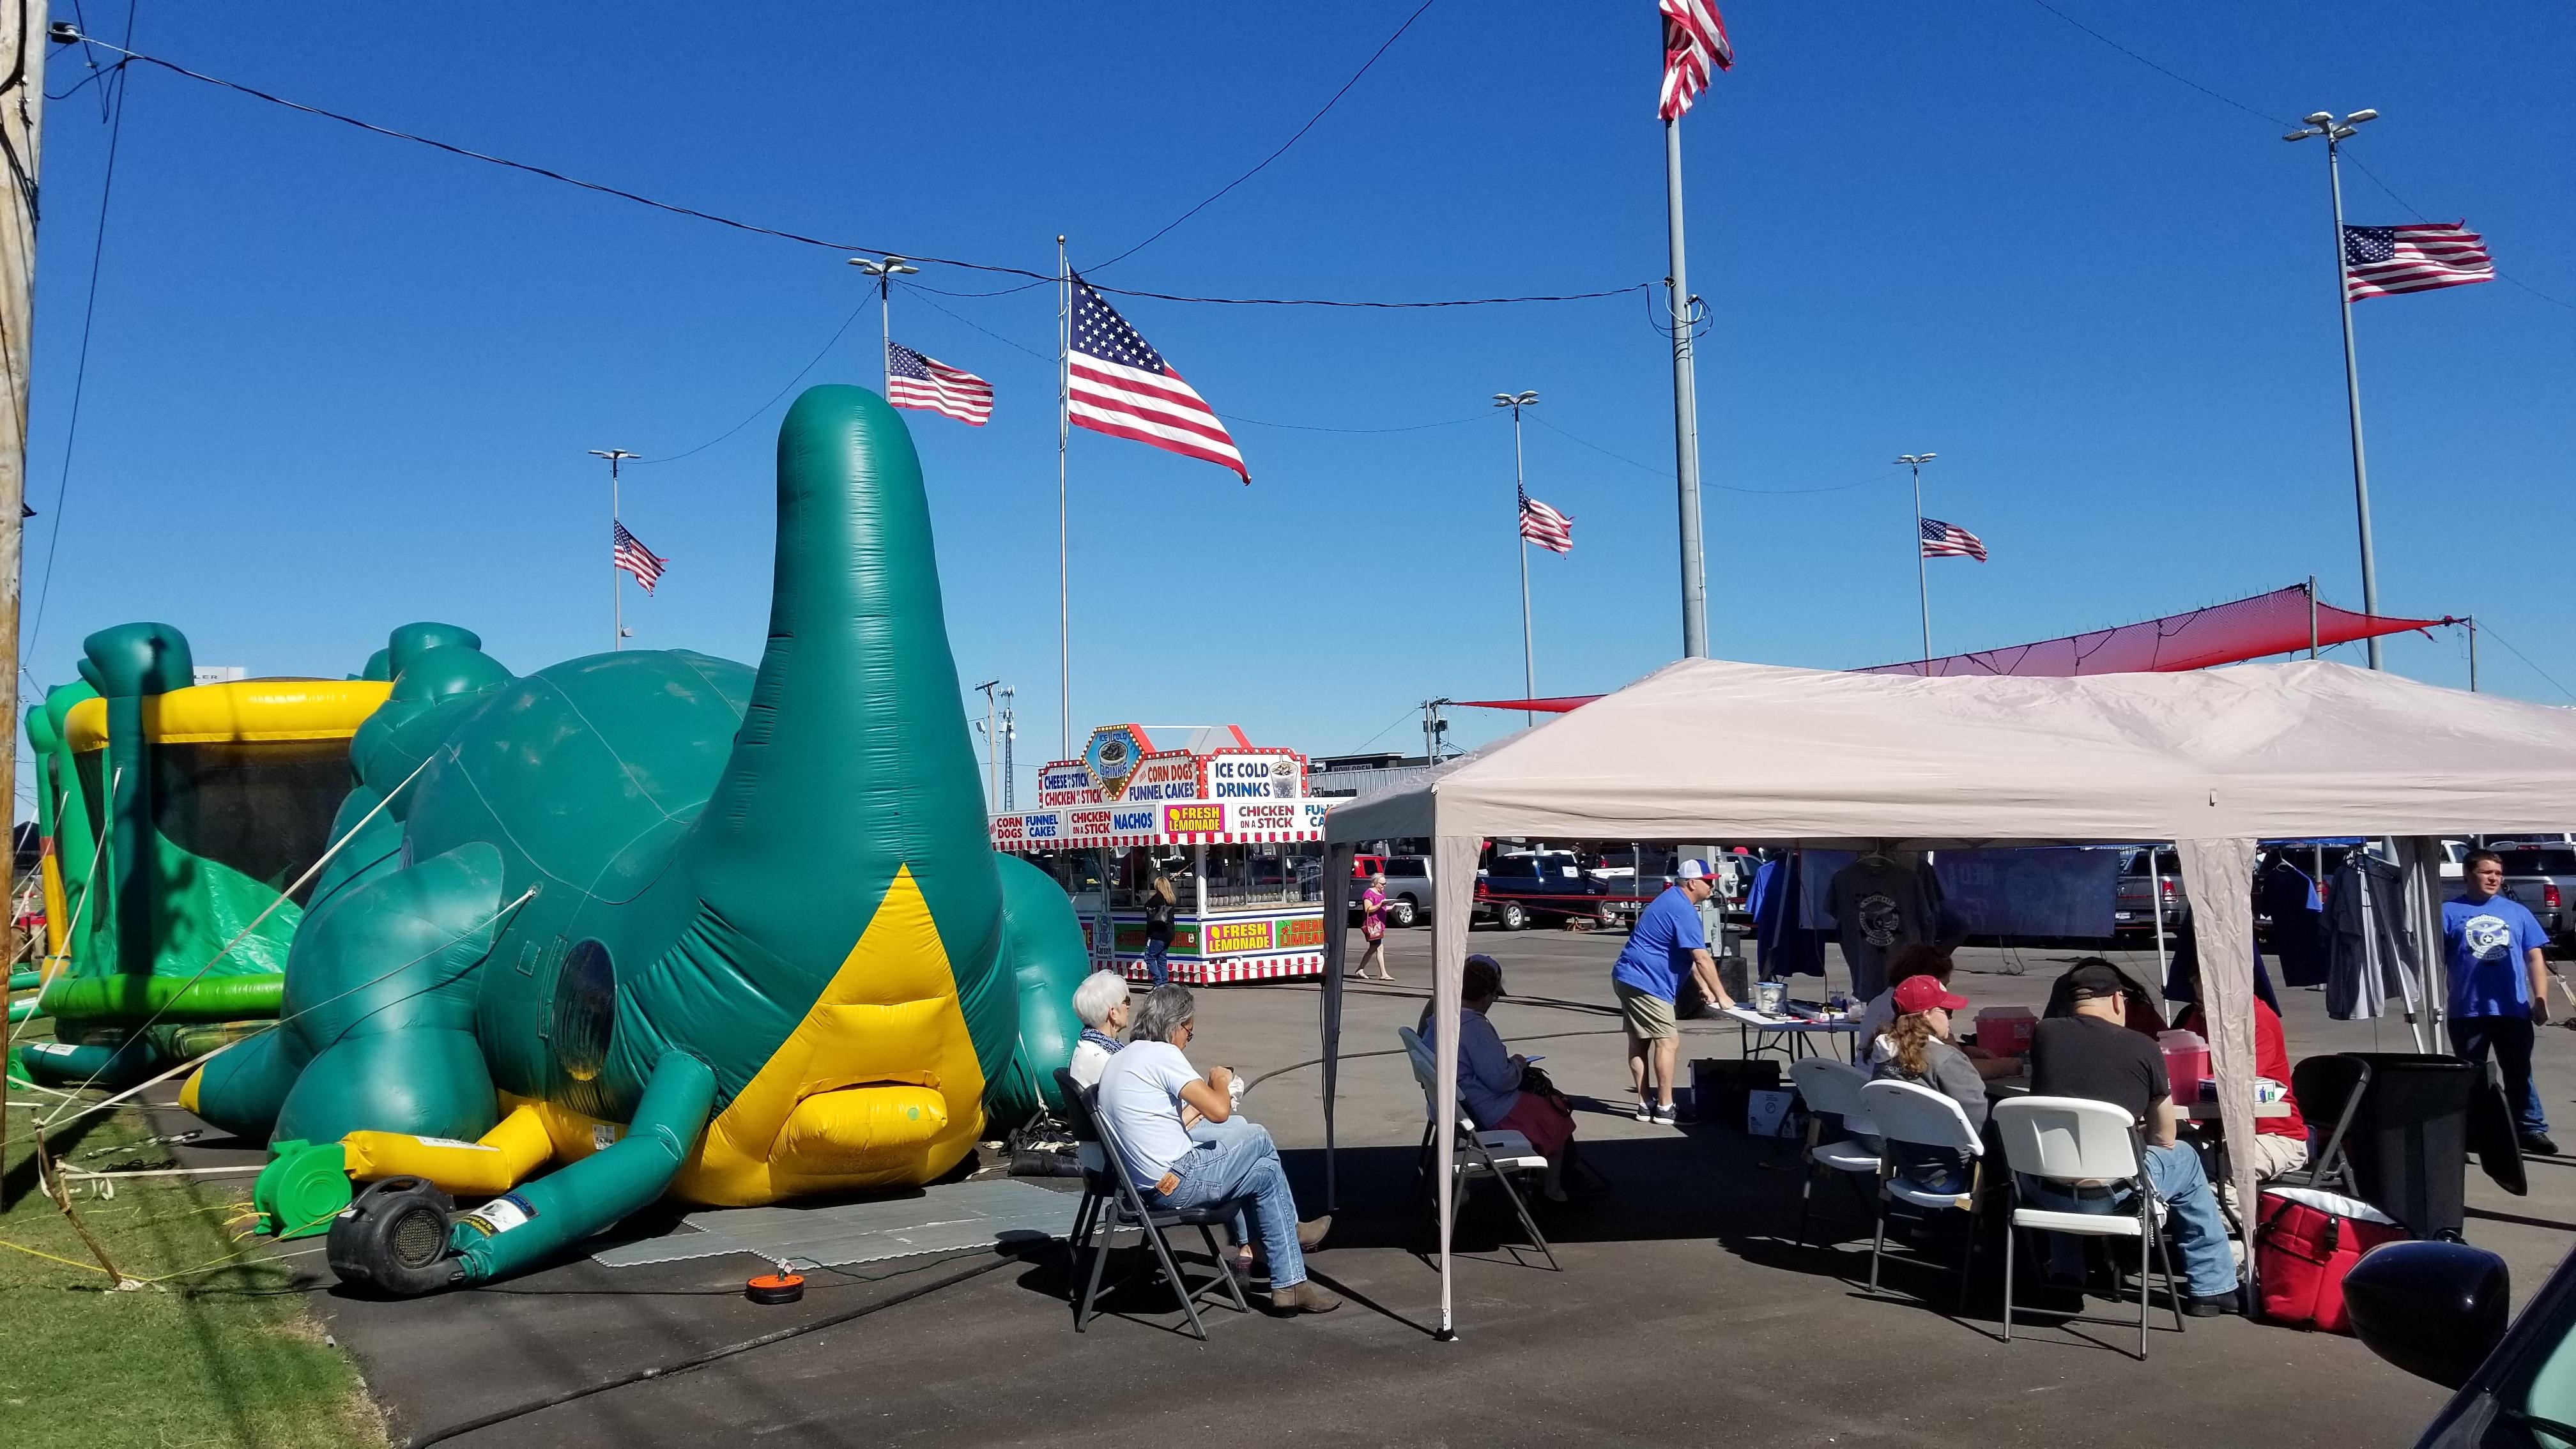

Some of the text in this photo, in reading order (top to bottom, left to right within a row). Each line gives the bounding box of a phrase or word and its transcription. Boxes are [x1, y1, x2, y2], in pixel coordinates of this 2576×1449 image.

[1113, 732, 1127, 740] COLD
[1100, 762, 1127, 778] DRINKS
[1147, 765, 1169, 783] CORN
[1170, 763, 1193, 781] DOGS
[1215, 763, 1269, 778] ICE COLD
[1045, 774, 1067, 790] CHEESE
[1071, 772, 1089, 788] STICK
[1045, 790, 1076, 806] CHICKEN
[1081, 788, 1103, 804] STICK
[1130, 782, 1195, 801] FUNNEL CAKES
[1216, 783, 1270, 797] DRINKS
[1071, 811, 1111, 824] CHICKEN
[1181, 807, 1220, 819] FRESH
[1239, 806, 1294, 816] CHICKEN
[997, 816, 1022, 828] CORN
[1025, 815, 1058, 826] FUNNEL
[1114, 812, 1153, 830] NACHOS
[1169, 819, 1220, 832] LEMONADE
[1257, 817, 1293, 829] STICK
[998, 828, 1022, 839] DOGS
[1029, 826, 1056, 838] CAKES
[1085, 823, 1110, 834] STICK
[1222, 923, 1267, 938] FRESH
[1292, 919, 1324, 933] CHER
[1209, 936, 1269, 953] LEMONADE
[1280, 931, 1324, 947] LIMEA
